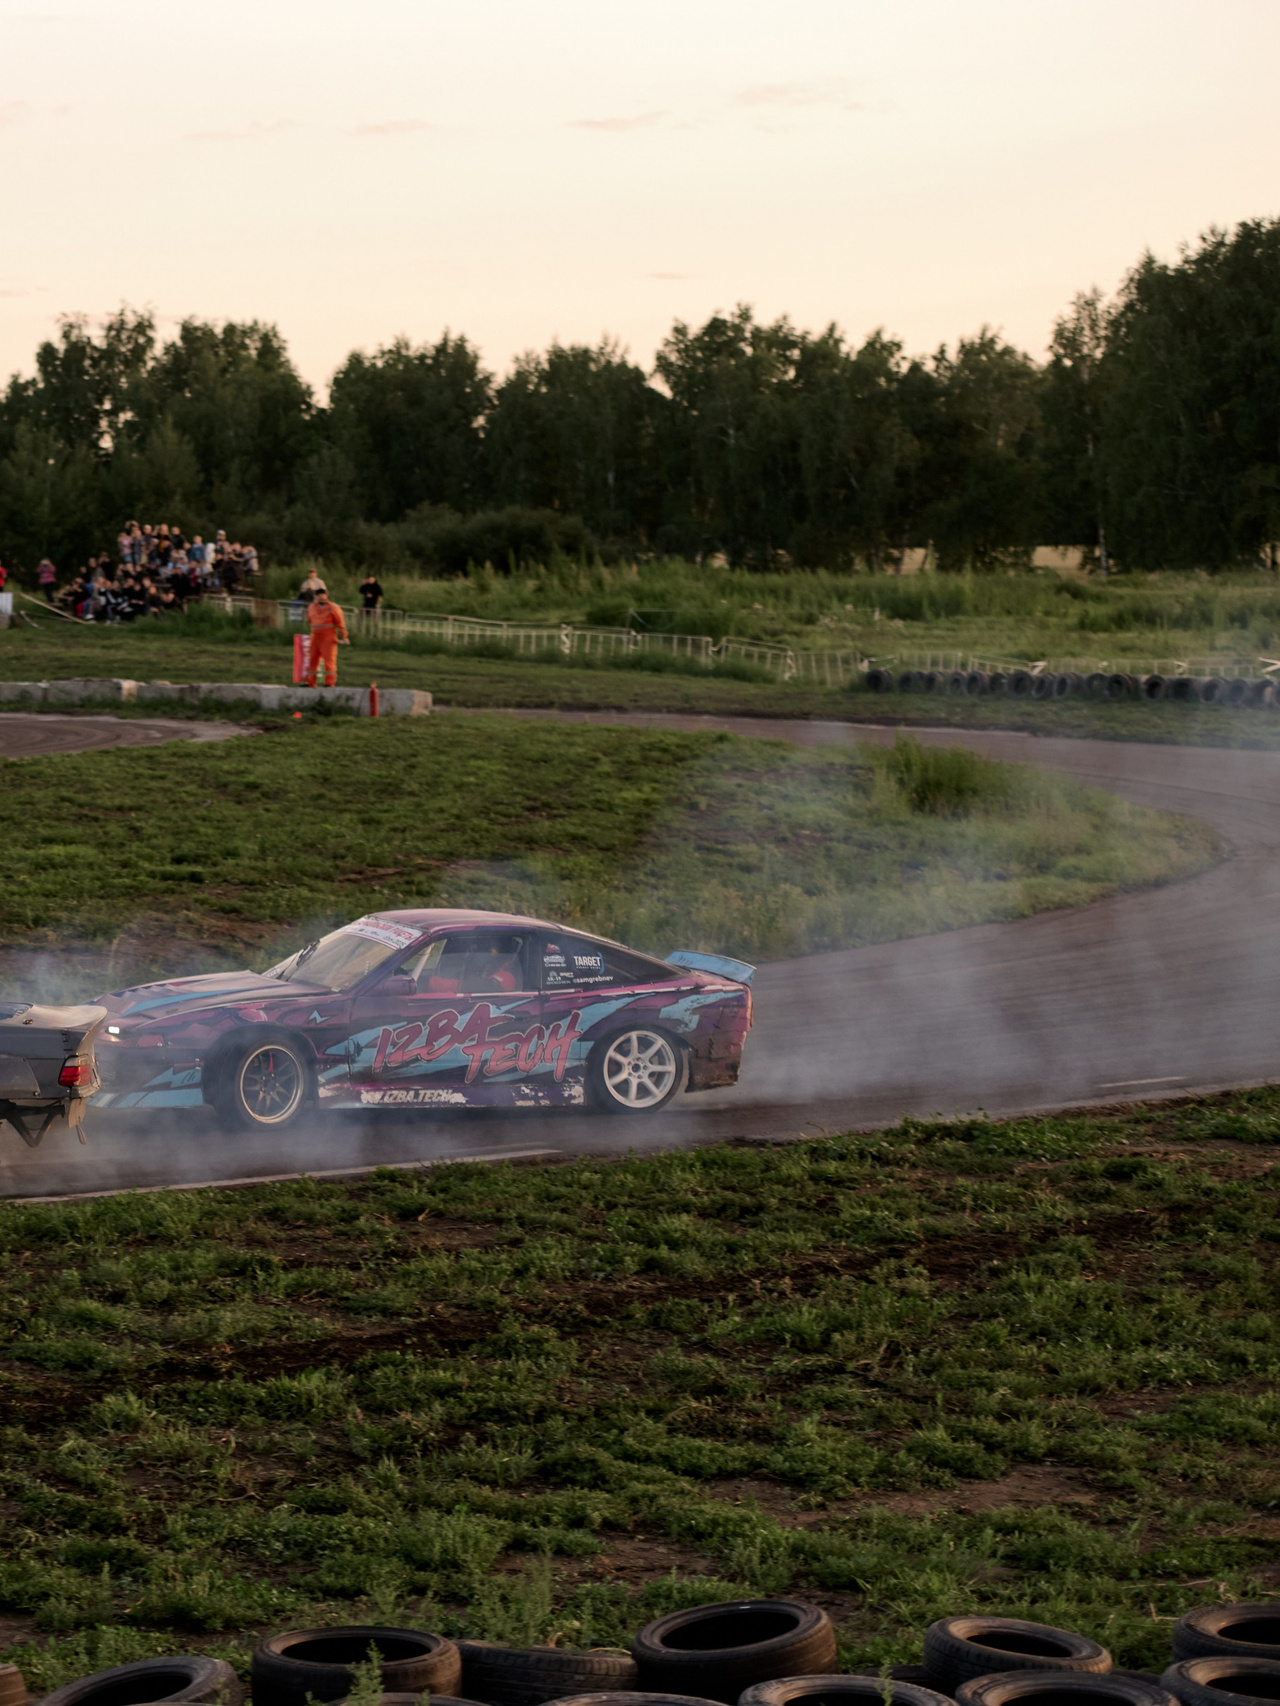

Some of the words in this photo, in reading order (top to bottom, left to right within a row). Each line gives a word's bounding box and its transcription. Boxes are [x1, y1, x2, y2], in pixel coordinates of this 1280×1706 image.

[573, 955, 601, 967] TARGET
[372, 1002, 516, 1075] IZBA
[461, 1010, 583, 1084] TECH
